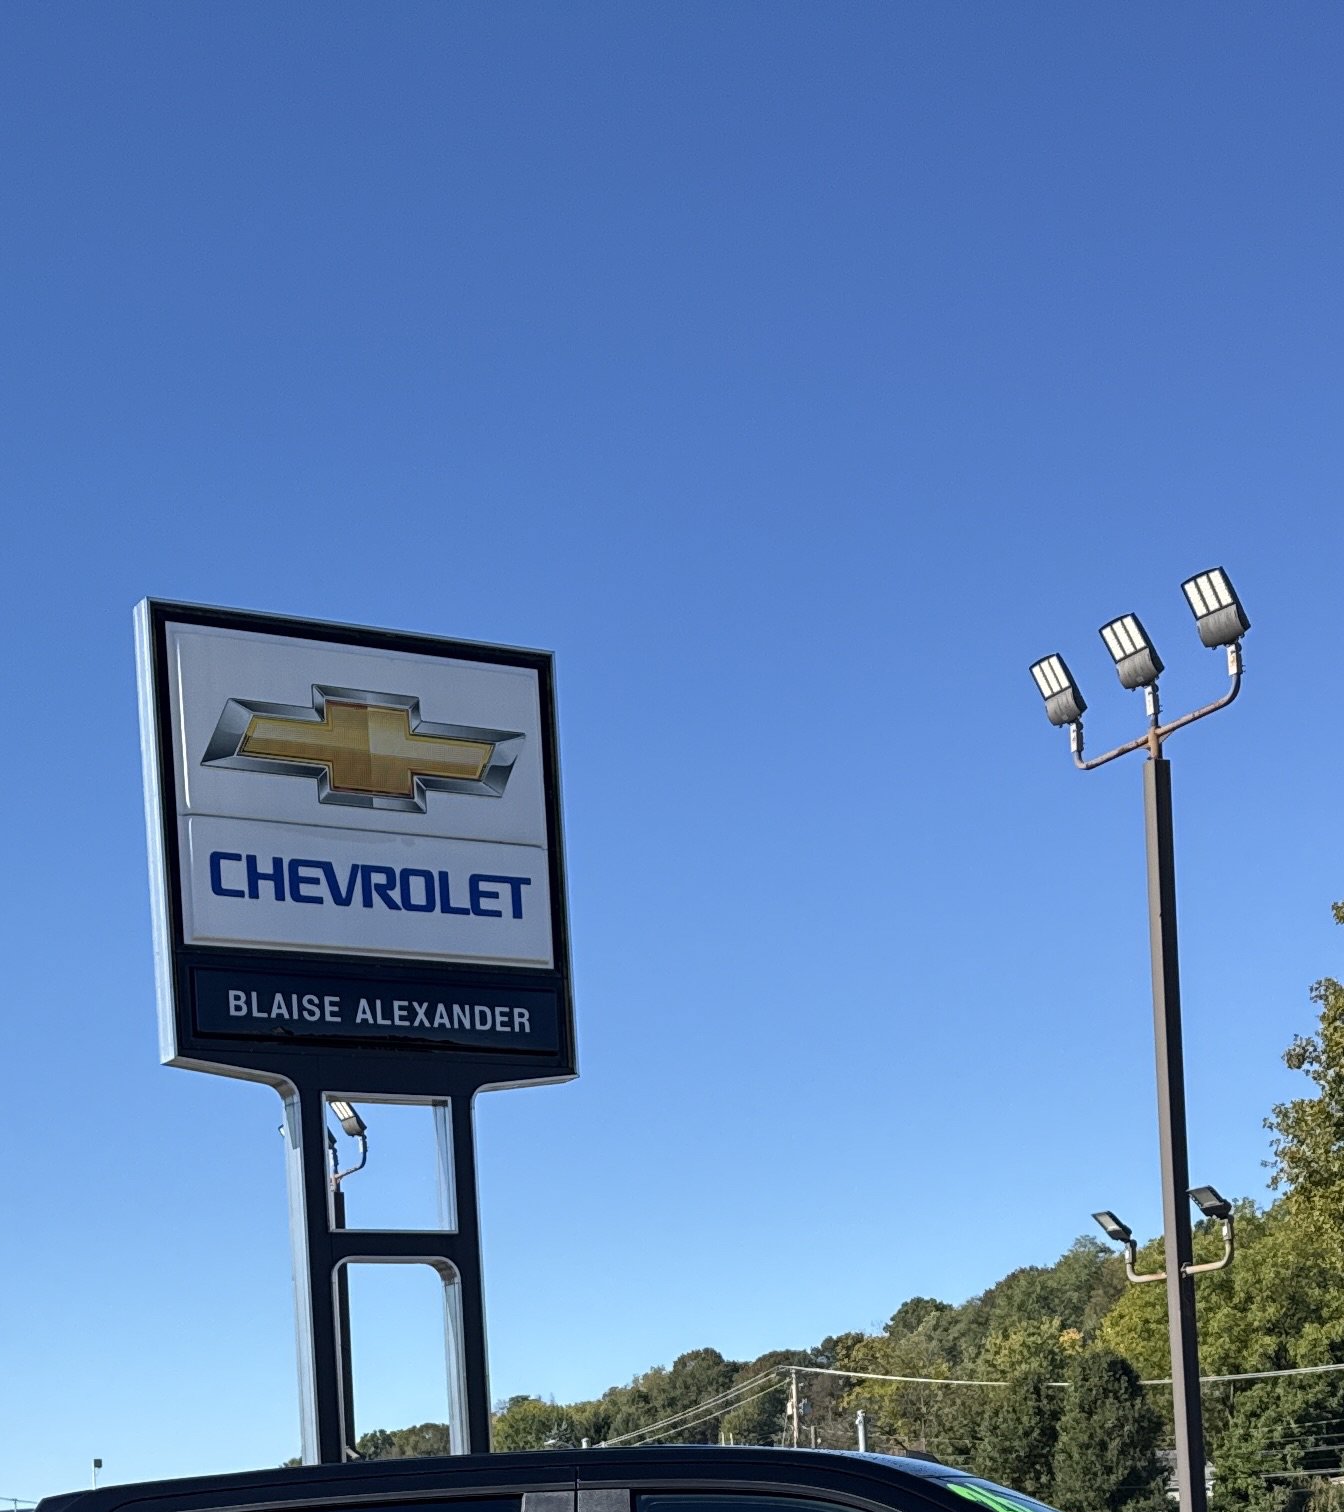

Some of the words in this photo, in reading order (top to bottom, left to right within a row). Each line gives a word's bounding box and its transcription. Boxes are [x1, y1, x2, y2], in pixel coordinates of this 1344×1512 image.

[210, 851, 531, 919] CHEVROLET
[228, 989, 342, 1023] BLAISE
[356, 998, 531, 1033] ALEXANDER
